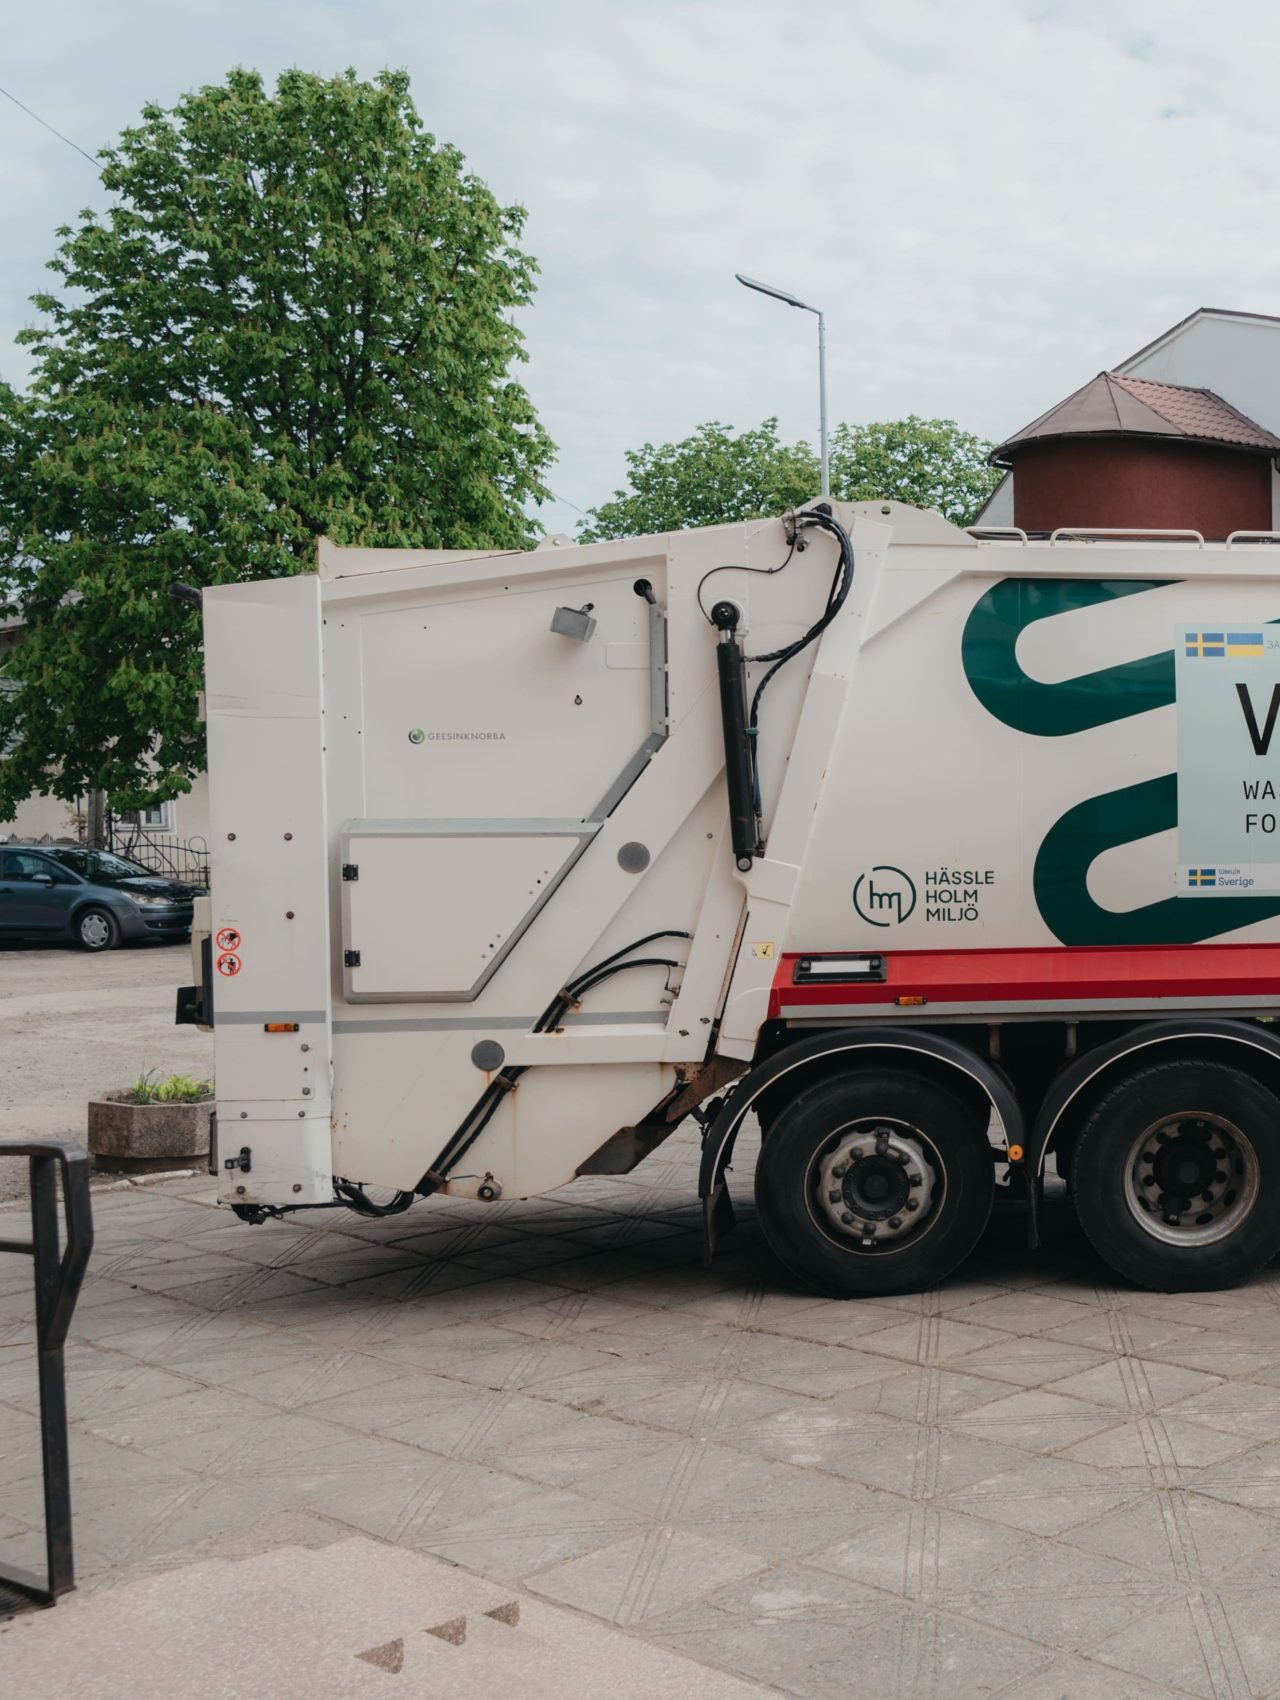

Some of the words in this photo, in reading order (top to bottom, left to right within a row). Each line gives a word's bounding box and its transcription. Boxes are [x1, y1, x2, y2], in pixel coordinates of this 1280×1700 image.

[1266, 640, 1280, 650] ЗА
[427, 732, 506, 741] GEESINKNORBA
[925, 867, 995, 885] HÄSSLE
[1218, 877, 1254, 888] Sverige
[926, 889, 978, 903] HOLM
[926, 903, 979, 922] MILJÖ
